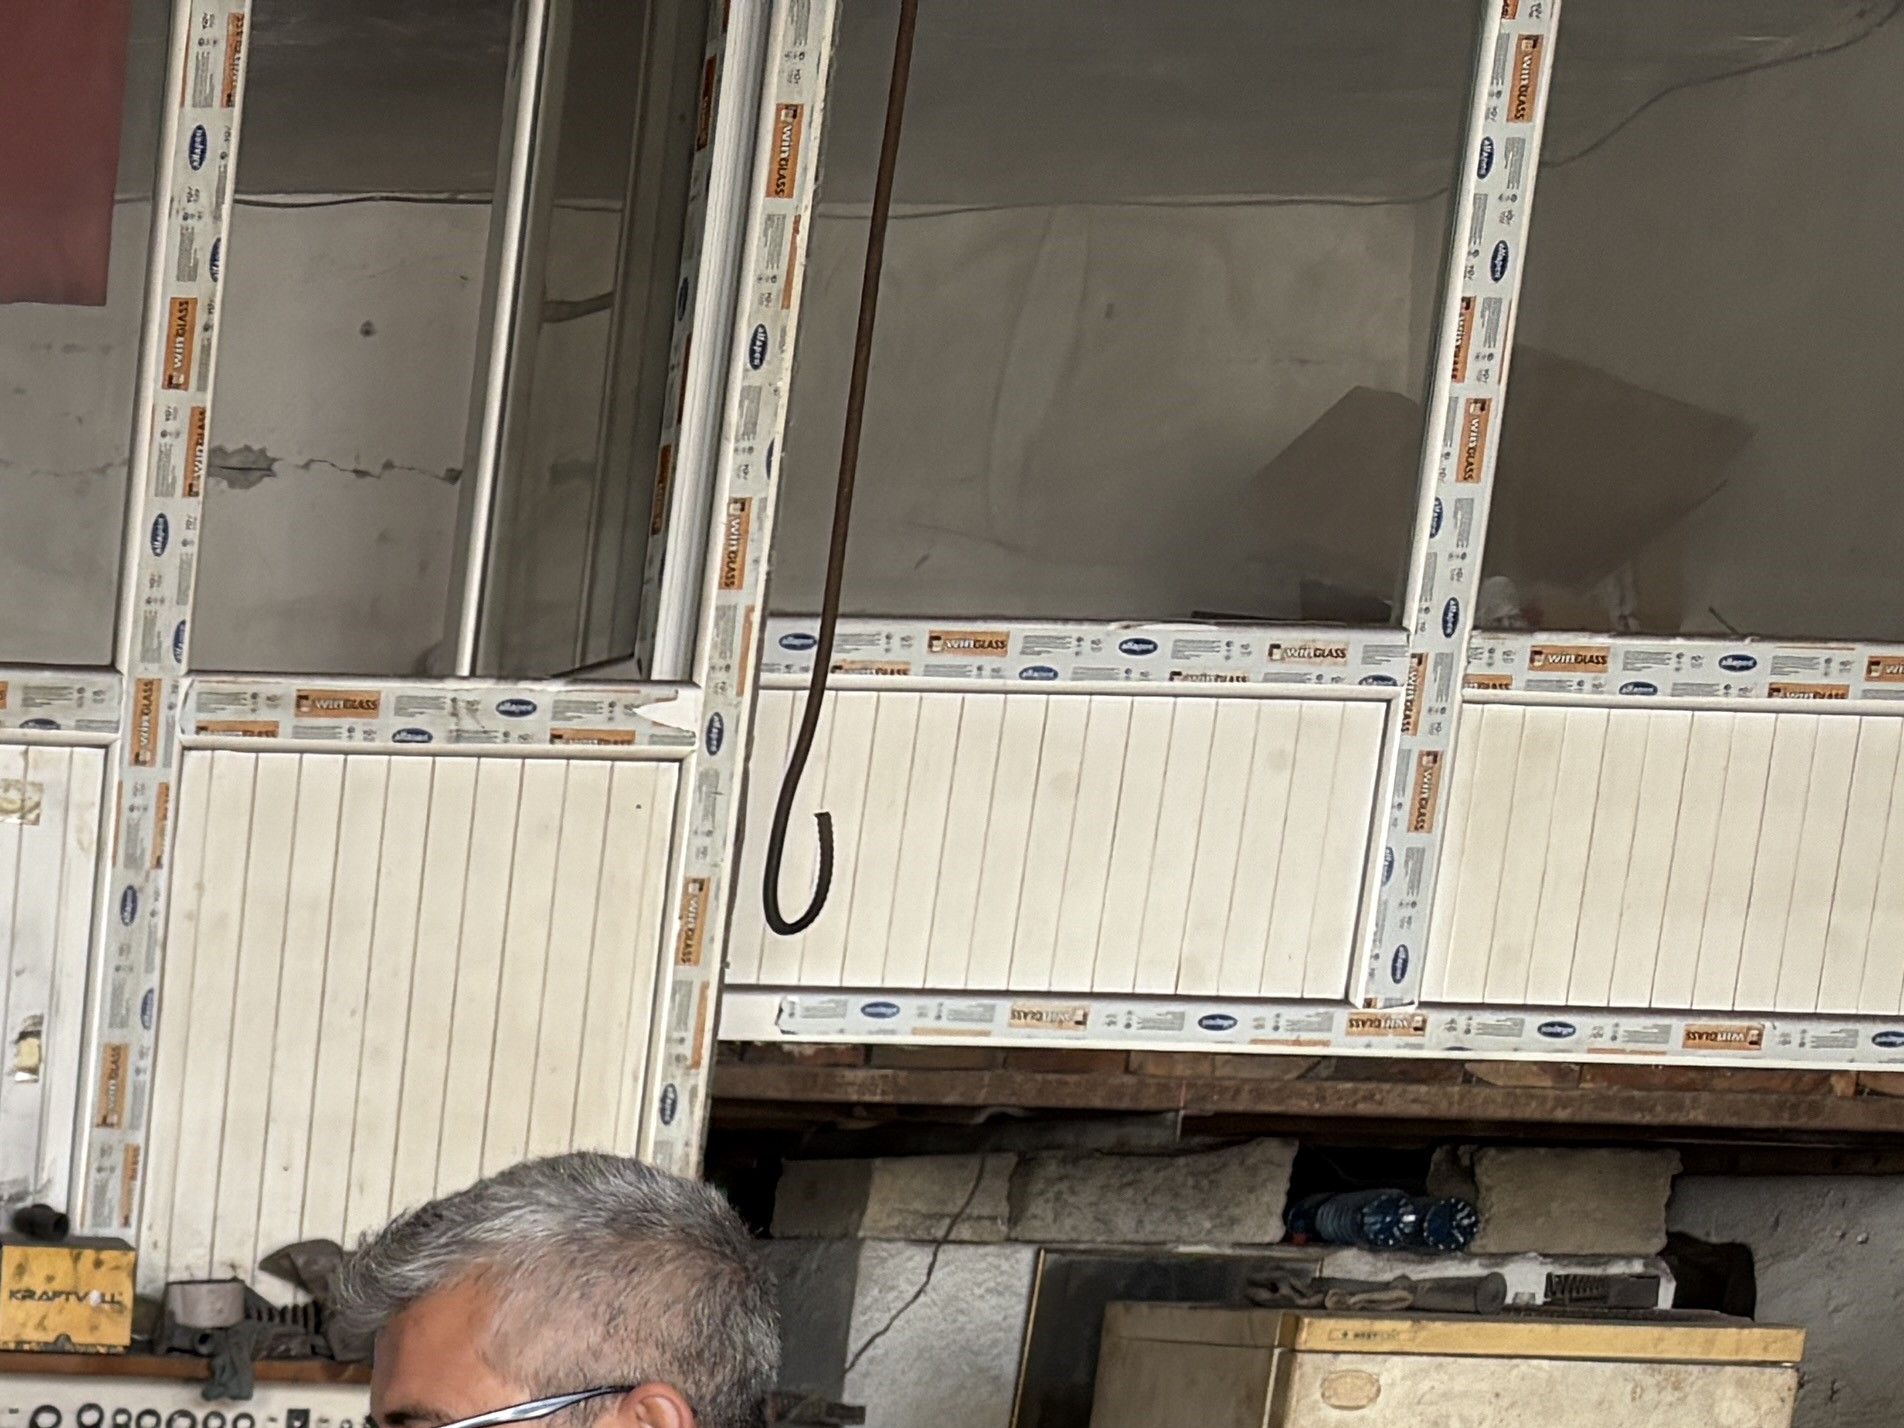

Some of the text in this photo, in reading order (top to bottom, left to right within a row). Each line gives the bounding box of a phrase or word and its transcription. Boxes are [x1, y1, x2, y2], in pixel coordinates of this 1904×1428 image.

[1515, 53, 1531, 120] winGLASS
[774, 123, 792, 197] winGLASS
[1463, 417, 1480, 481] winGLASS
[724, 517, 740, 588] winGLASS
[943, 639, 1007, 651] winGLASS
[1283, 645, 1347, 660] winGLASS
[1547, 652, 1608, 666] winGLASS
[314, 697, 378, 711] winGLASS
[9, 1289, 122, 1307] KRAFTVLL
